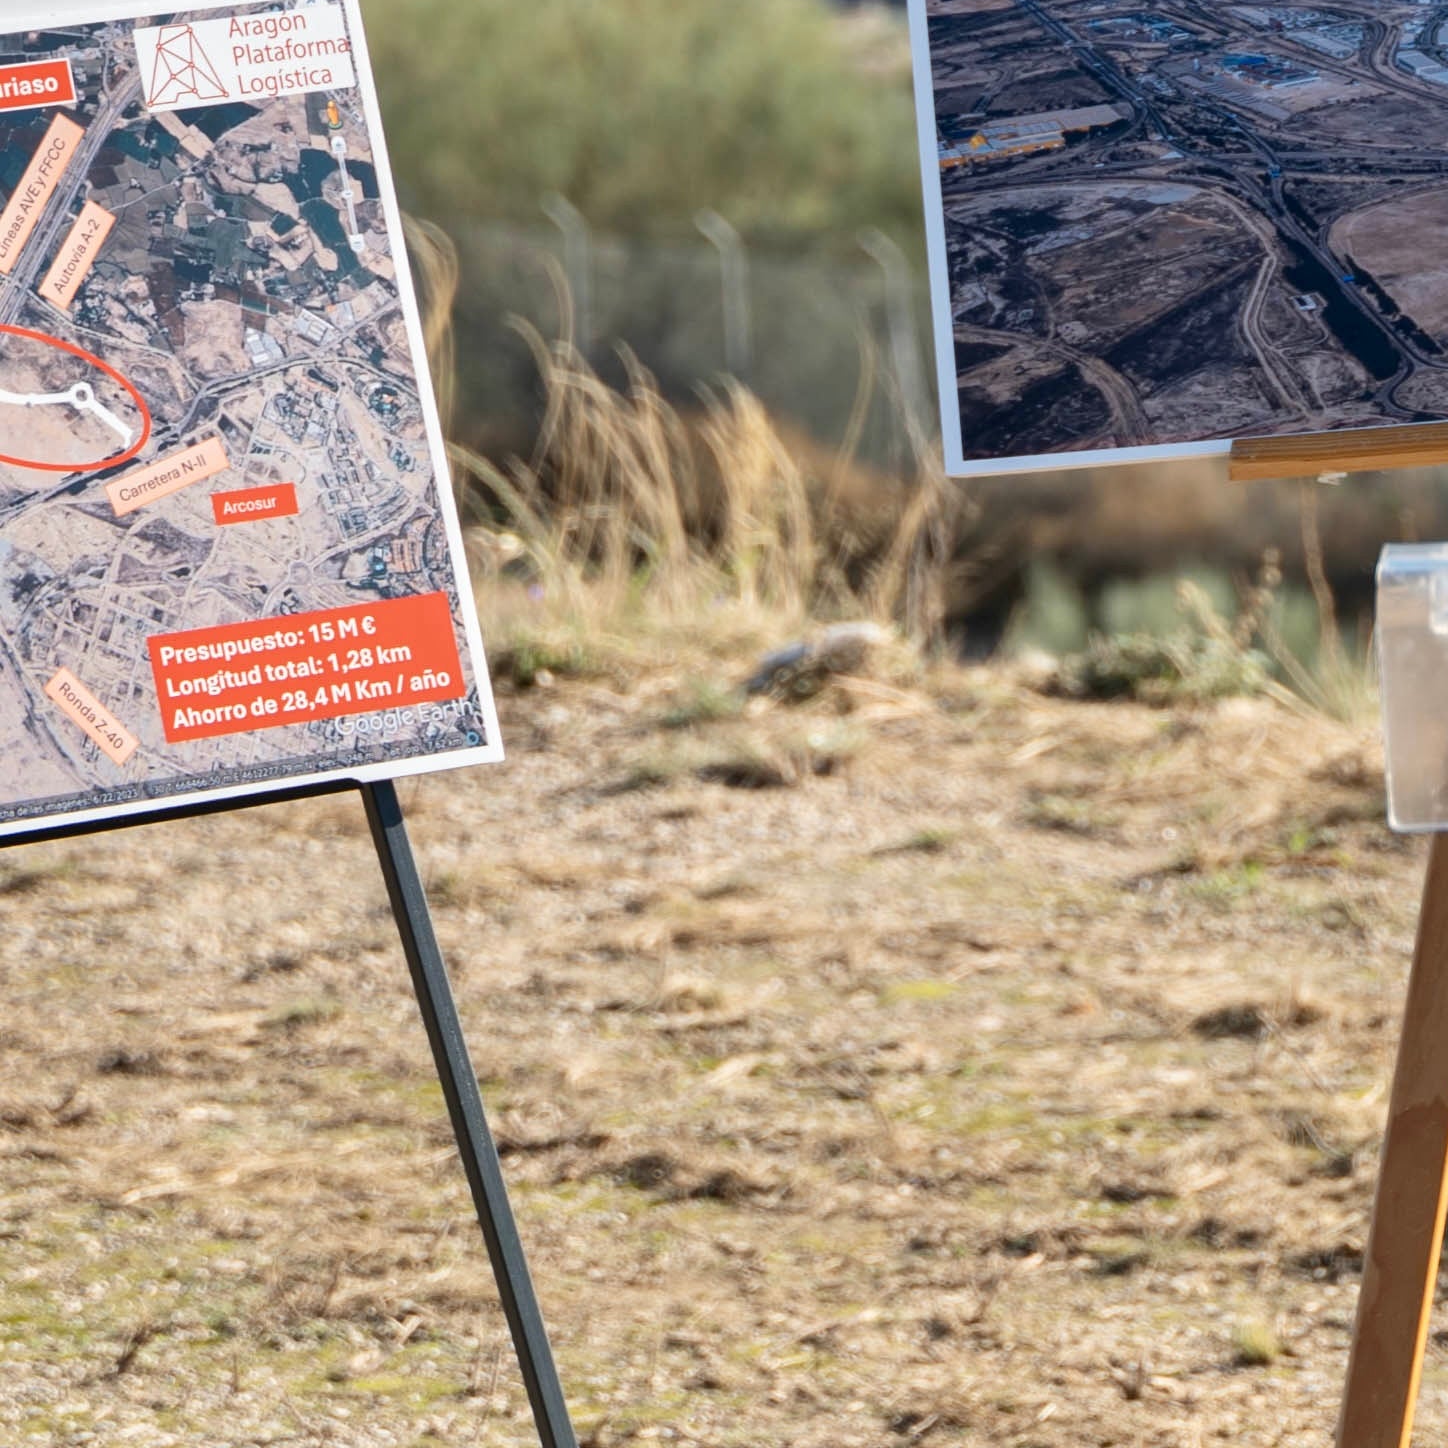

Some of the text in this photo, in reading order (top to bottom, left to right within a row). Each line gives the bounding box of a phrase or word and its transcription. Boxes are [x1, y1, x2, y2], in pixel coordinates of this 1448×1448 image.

[229, 7, 306, 39] Aragón
[233, 37, 350, 66] Plataforma
[238, 66, 332, 99] Logística
[20, 183, 41, 215] AVE
[39, 137, 66, 177] FFCC
[54, 218, 100, 295] Autovía A-2
[119, 454, 207, 502] Carretera N-II
[223, 496, 277, 515] Arcosur
[160, 615, 376, 666] Presupuesto: 15 M €
[166, 644, 412, 698] Longitud total: 1,28 km
[58, 681, 124, 751] Ronda Z-40
[173, 669, 451, 730] Ahorro de 28,4 M Km / año
[334, 698, 475, 736] Google Earth
